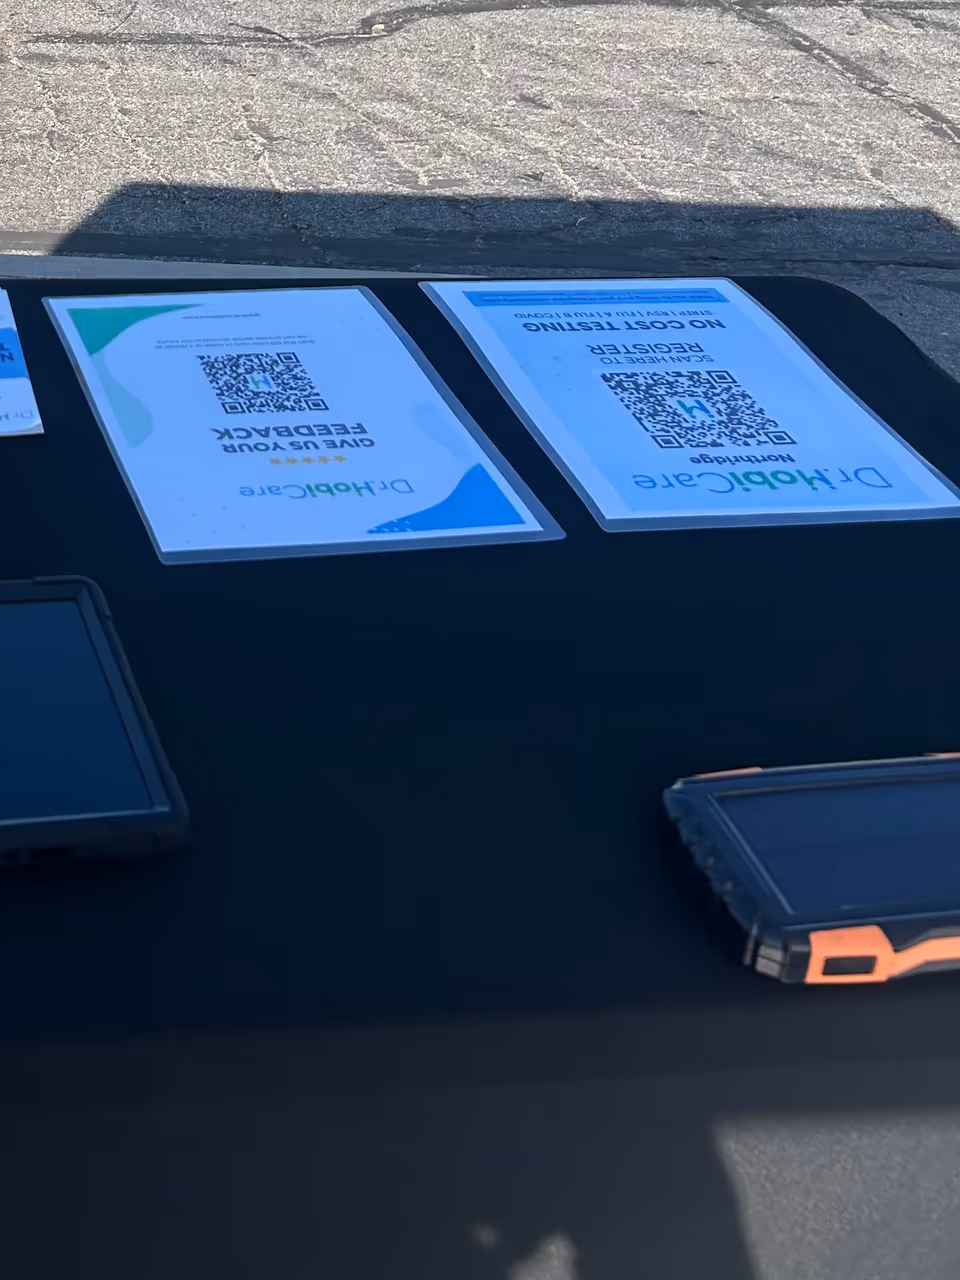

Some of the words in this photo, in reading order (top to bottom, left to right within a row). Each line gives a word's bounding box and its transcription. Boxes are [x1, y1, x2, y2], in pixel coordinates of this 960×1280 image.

[522, 321, 621, 332] TESTING
[625, 320, 686, 331] COST
[689, 319, 727, 329] NO
[586, 342, 705, 356] REGISTER
[600, 356, 626, 365] TO
[628, 355, 668, 364] HERE
[669, 354, 715, 363] SCAN
[209, 422, 369, 440] FEEDBACK
[221, 441, 287, 454] YOUR
[289, 440, 320, 451] US
[322, 437, 375, 449] GIVE
[689, 453, 796, 466] Northridge
